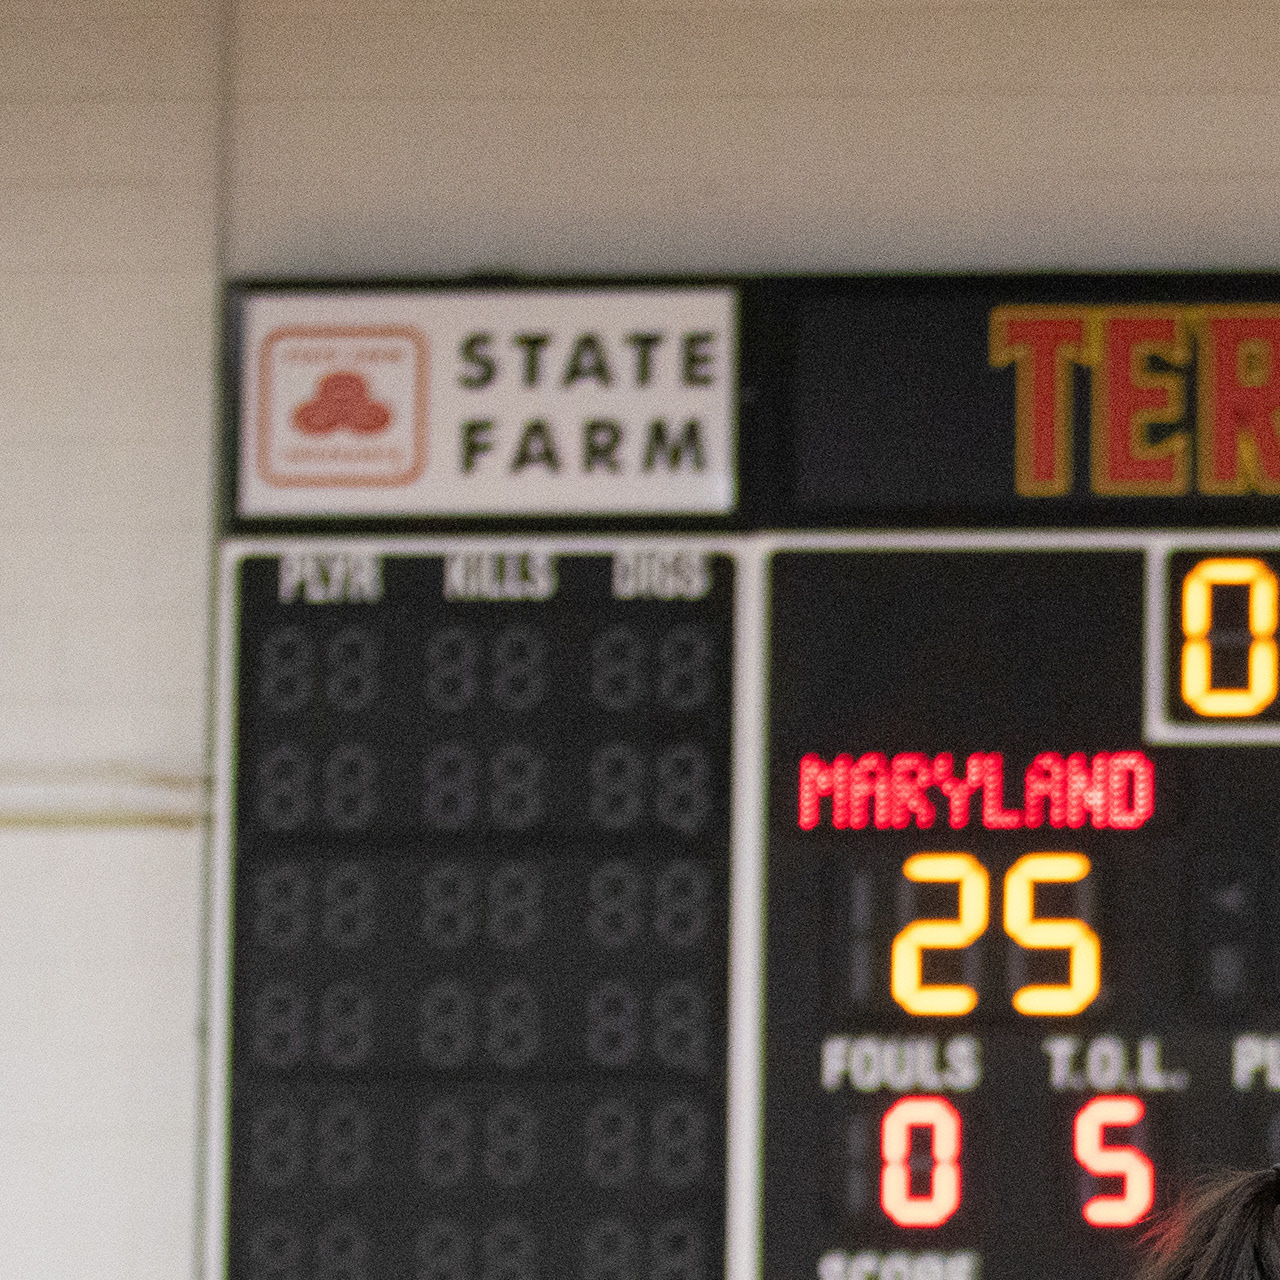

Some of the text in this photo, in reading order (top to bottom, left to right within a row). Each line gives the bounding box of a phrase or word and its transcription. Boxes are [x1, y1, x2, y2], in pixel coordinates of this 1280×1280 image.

[457, 330, 718, 389] STATE
[459, 417, 708, 476] FARM
[444, 546, 558, 601] KILLS
[798, 750, 1155, 831] MARYLAND
[890, 851, 1102, 1017] 25
[819, 1034, 1190, 1091] FOULS T.O.L.
[880, 1095, 962, 1228] 0
